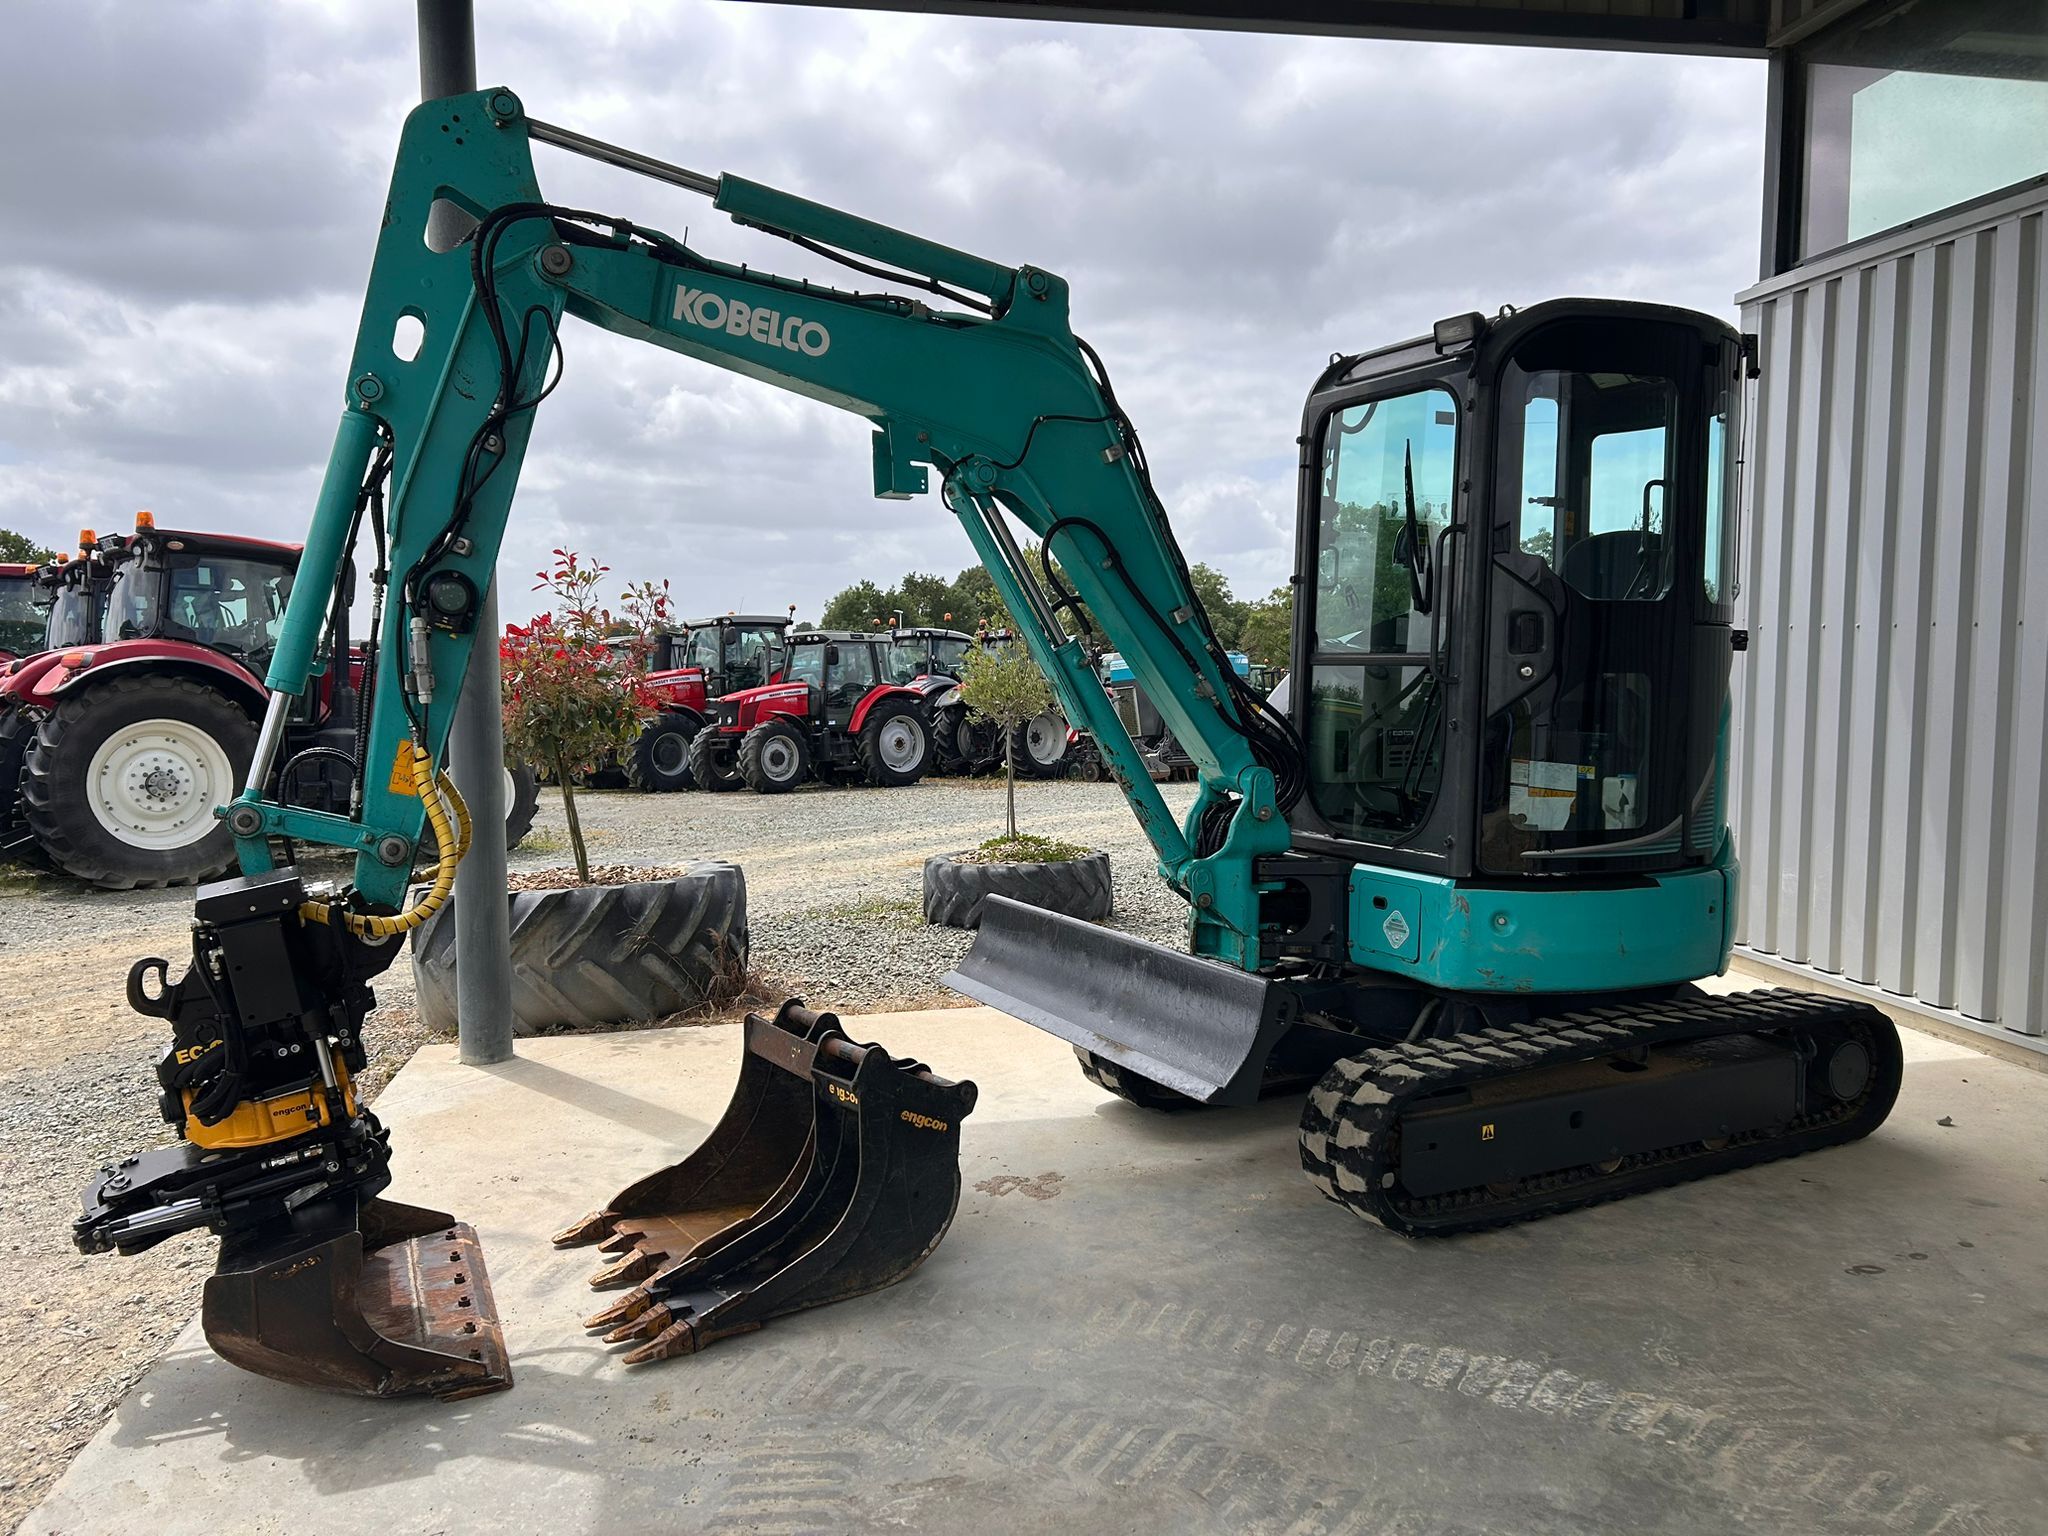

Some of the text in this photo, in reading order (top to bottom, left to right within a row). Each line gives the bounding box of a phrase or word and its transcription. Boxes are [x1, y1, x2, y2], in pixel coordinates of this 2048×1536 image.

[672, 284, 830, 357] KOBELCO
[272, 1103, 307, 1117] engcon
[900, 1109, 948, 1131] engcon
